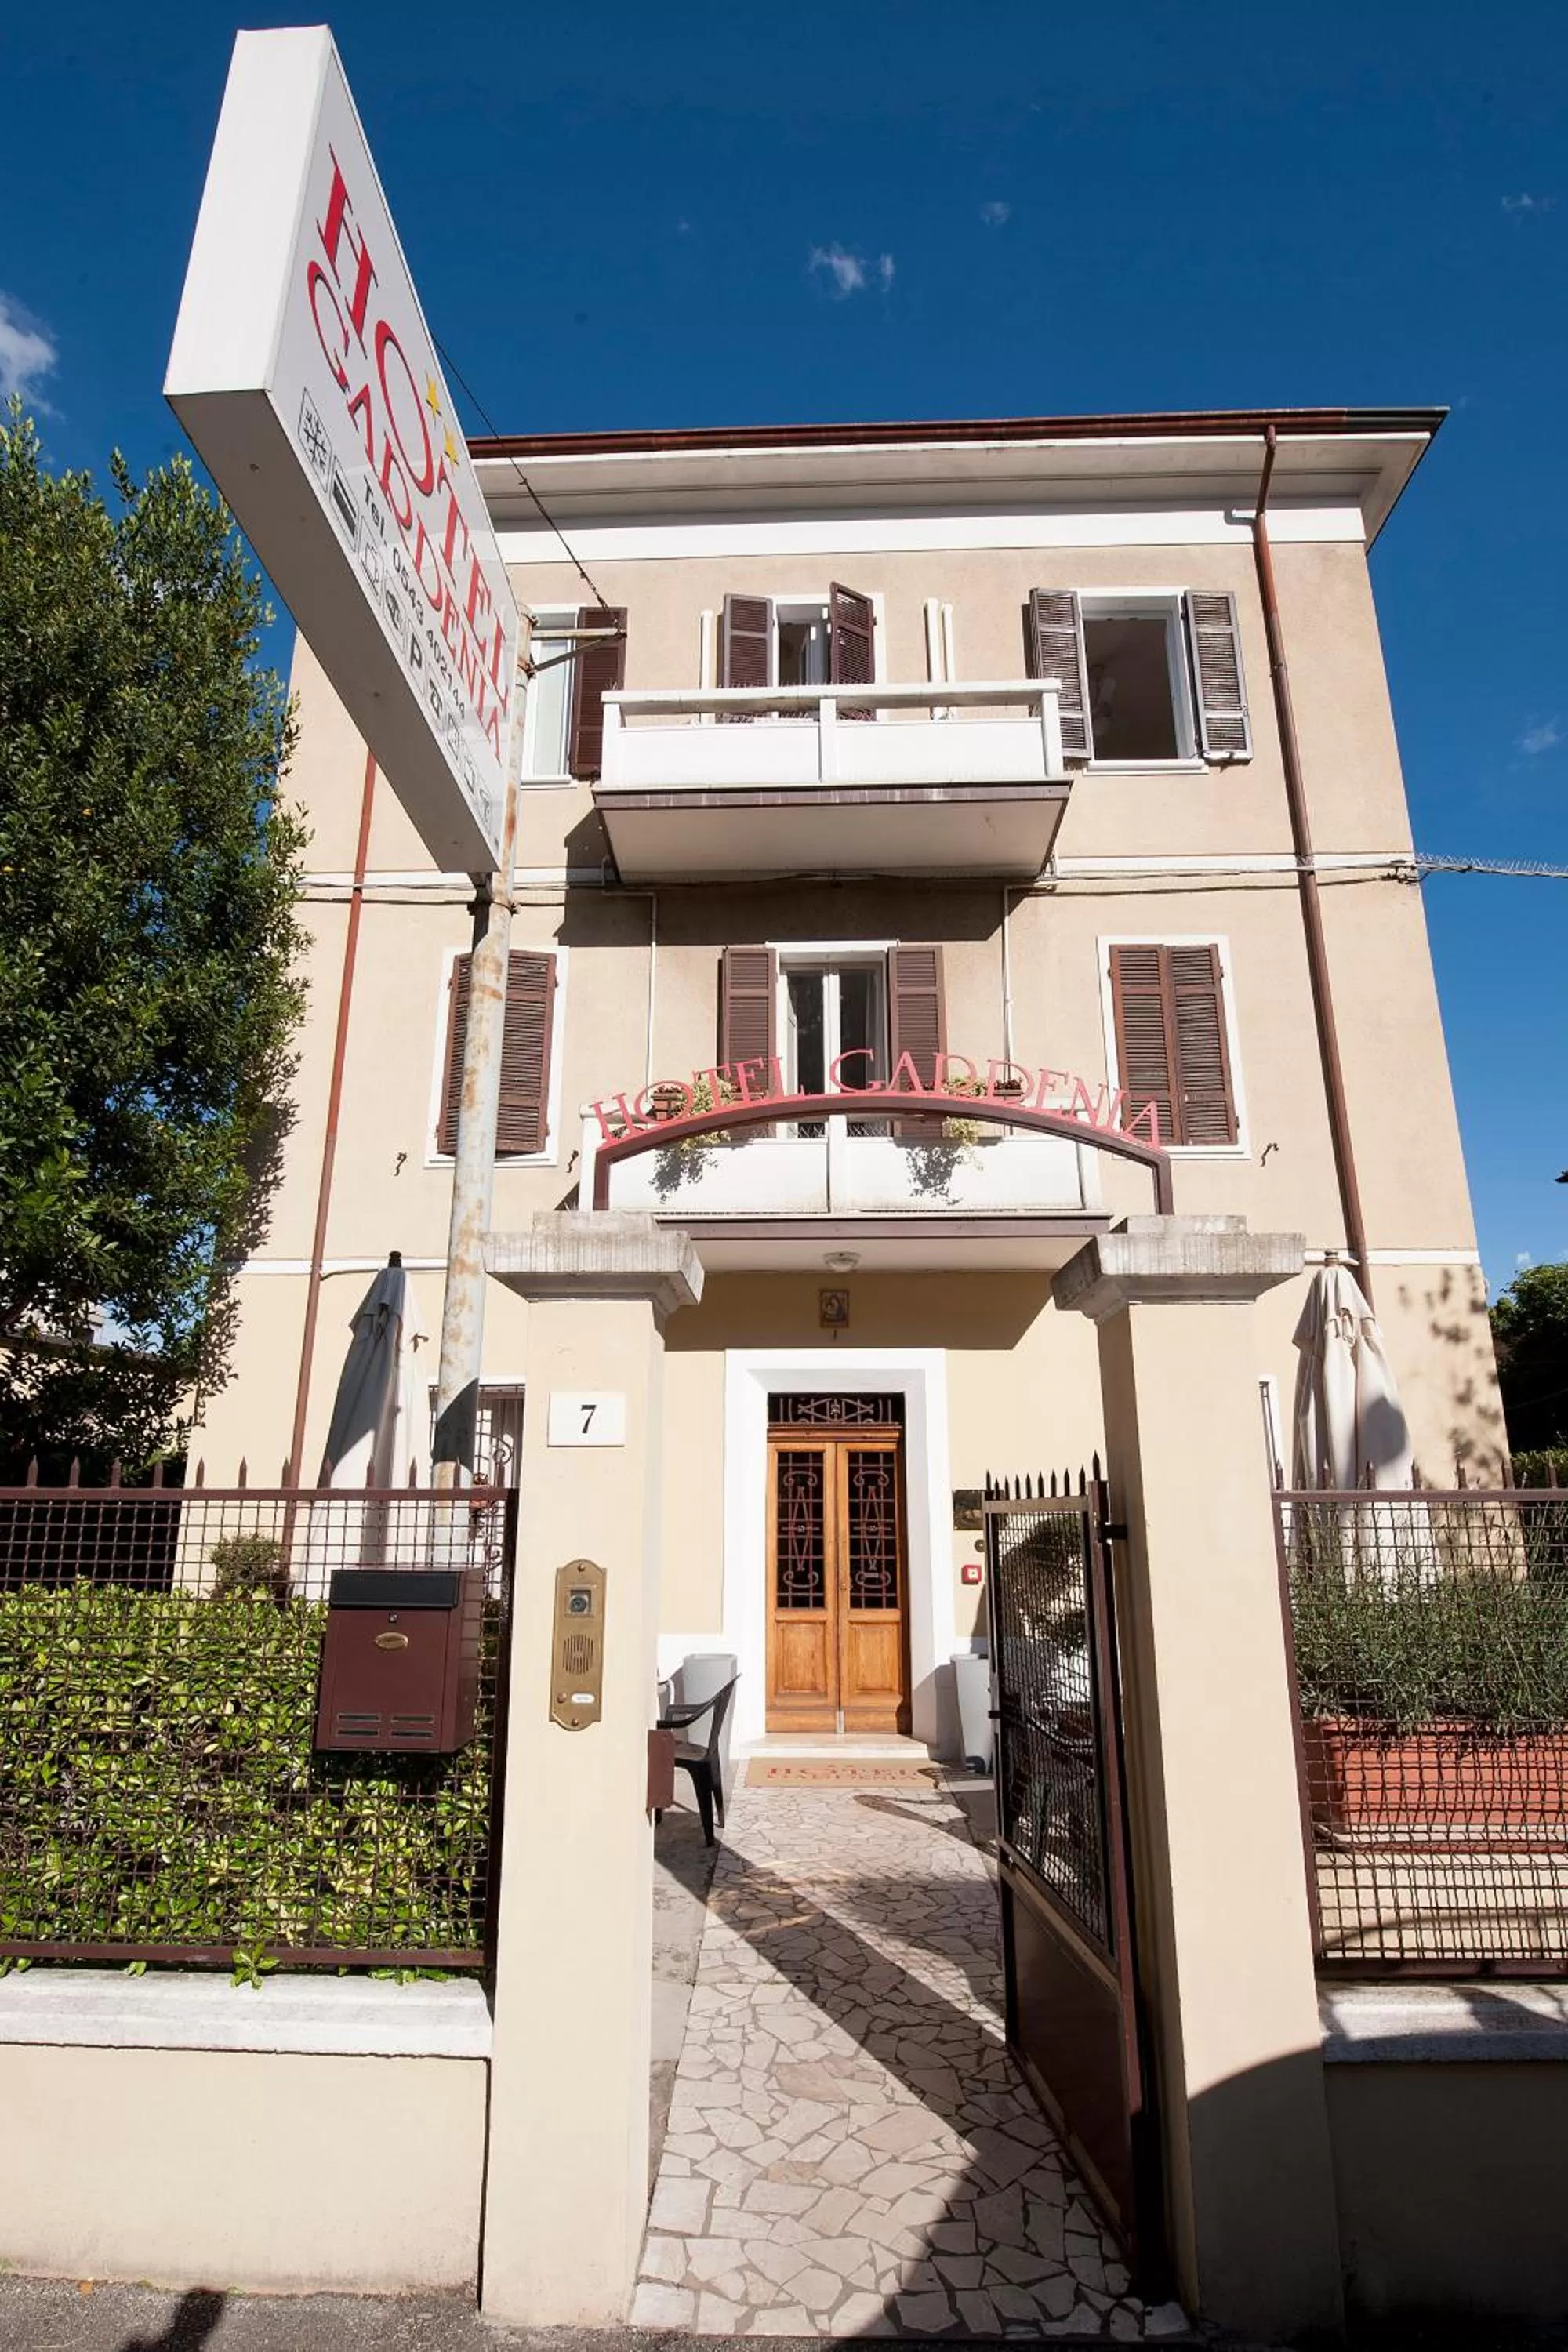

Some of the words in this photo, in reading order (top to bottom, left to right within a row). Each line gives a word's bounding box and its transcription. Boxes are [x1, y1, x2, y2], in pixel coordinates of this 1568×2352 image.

[315, 142, 509, 719] HOTEL
[307, 260, 502, 768] GARDENIA
[364, 474, 387, 547] Tel.
[393, 548, 424, 625] 0543
[590, 1056, 806, 1143] HOTEL
[829, 1048, 1160, 1149] GARDENIA
[581, 1404, 597, 1434] 7
